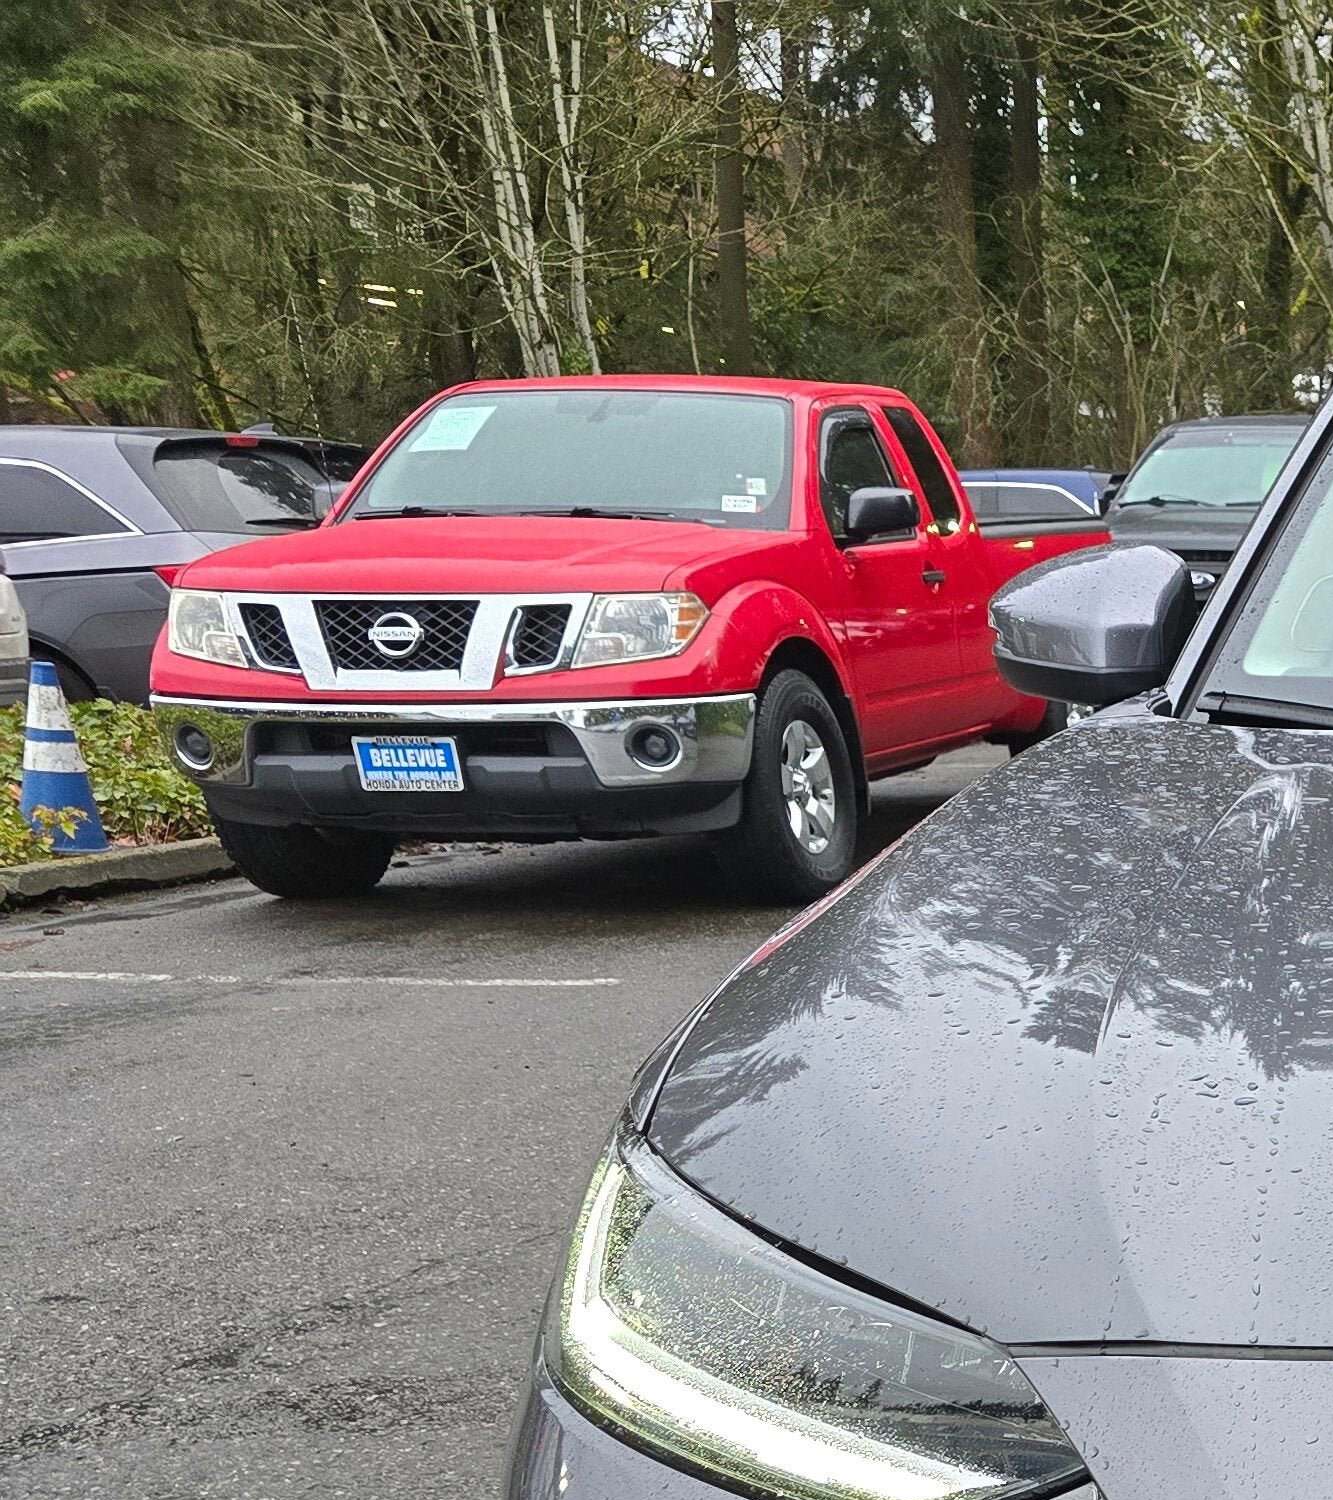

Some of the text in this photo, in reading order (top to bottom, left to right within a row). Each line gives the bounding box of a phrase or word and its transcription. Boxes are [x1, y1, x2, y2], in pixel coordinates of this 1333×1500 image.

[372, 630, 416, 638] NISSAN
[369, 748, 447, 768] BELLEVUE
[366, 780, 460, 790] HONDA AUTO CENTER
